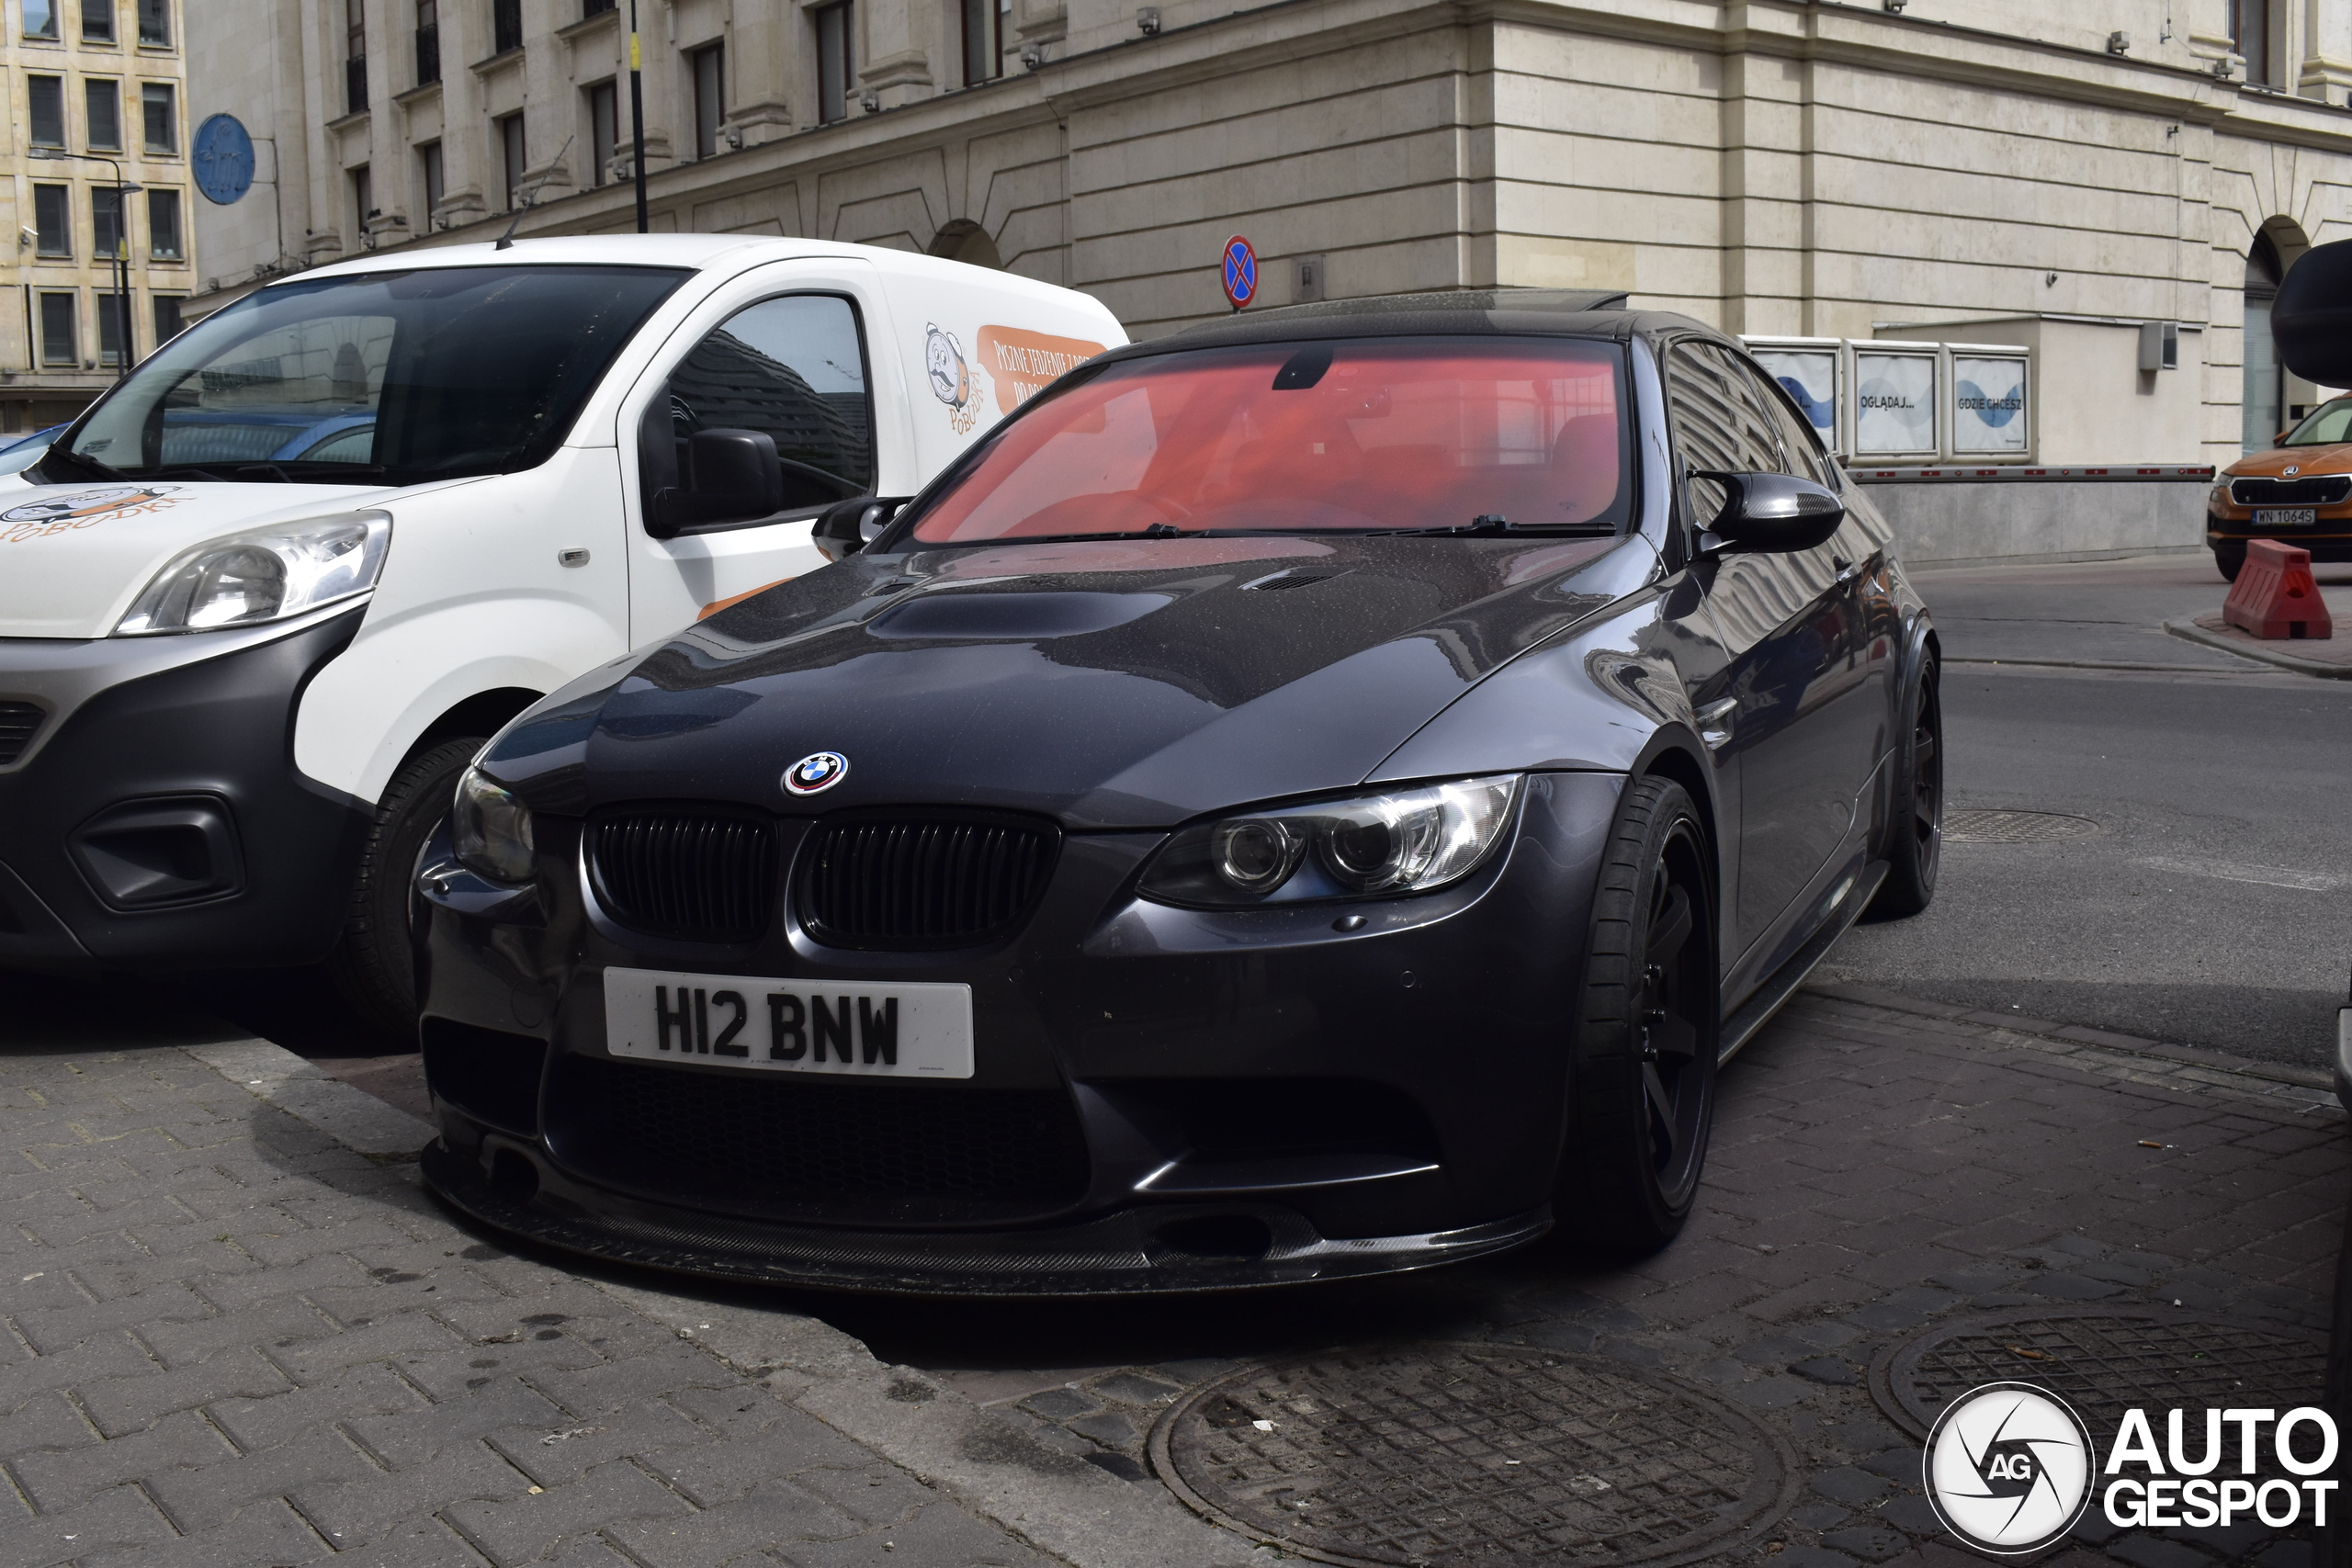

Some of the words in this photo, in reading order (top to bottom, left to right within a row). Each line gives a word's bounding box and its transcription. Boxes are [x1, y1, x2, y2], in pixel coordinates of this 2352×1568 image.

[993, 340, 1030, 373] PYSZNE
[1027, 348, 1067, 377] JEDZENIE
[949, 370, 984, 435] POBUDKA
[1860, 396, 1915, 412] OGLĄDAJ...
[1958, 398, 1985, 410] GDZIE
[1986, 398, 2022, 411] CHCESZ
[0, 497, 197, 543] POBUDKA
[2258, 511, 2273, 523] WN
[2278, 510, 2312, 523] 1064S
[803, 756, 838, 767] BMW
[767, 993, 899, 1066] BNW
